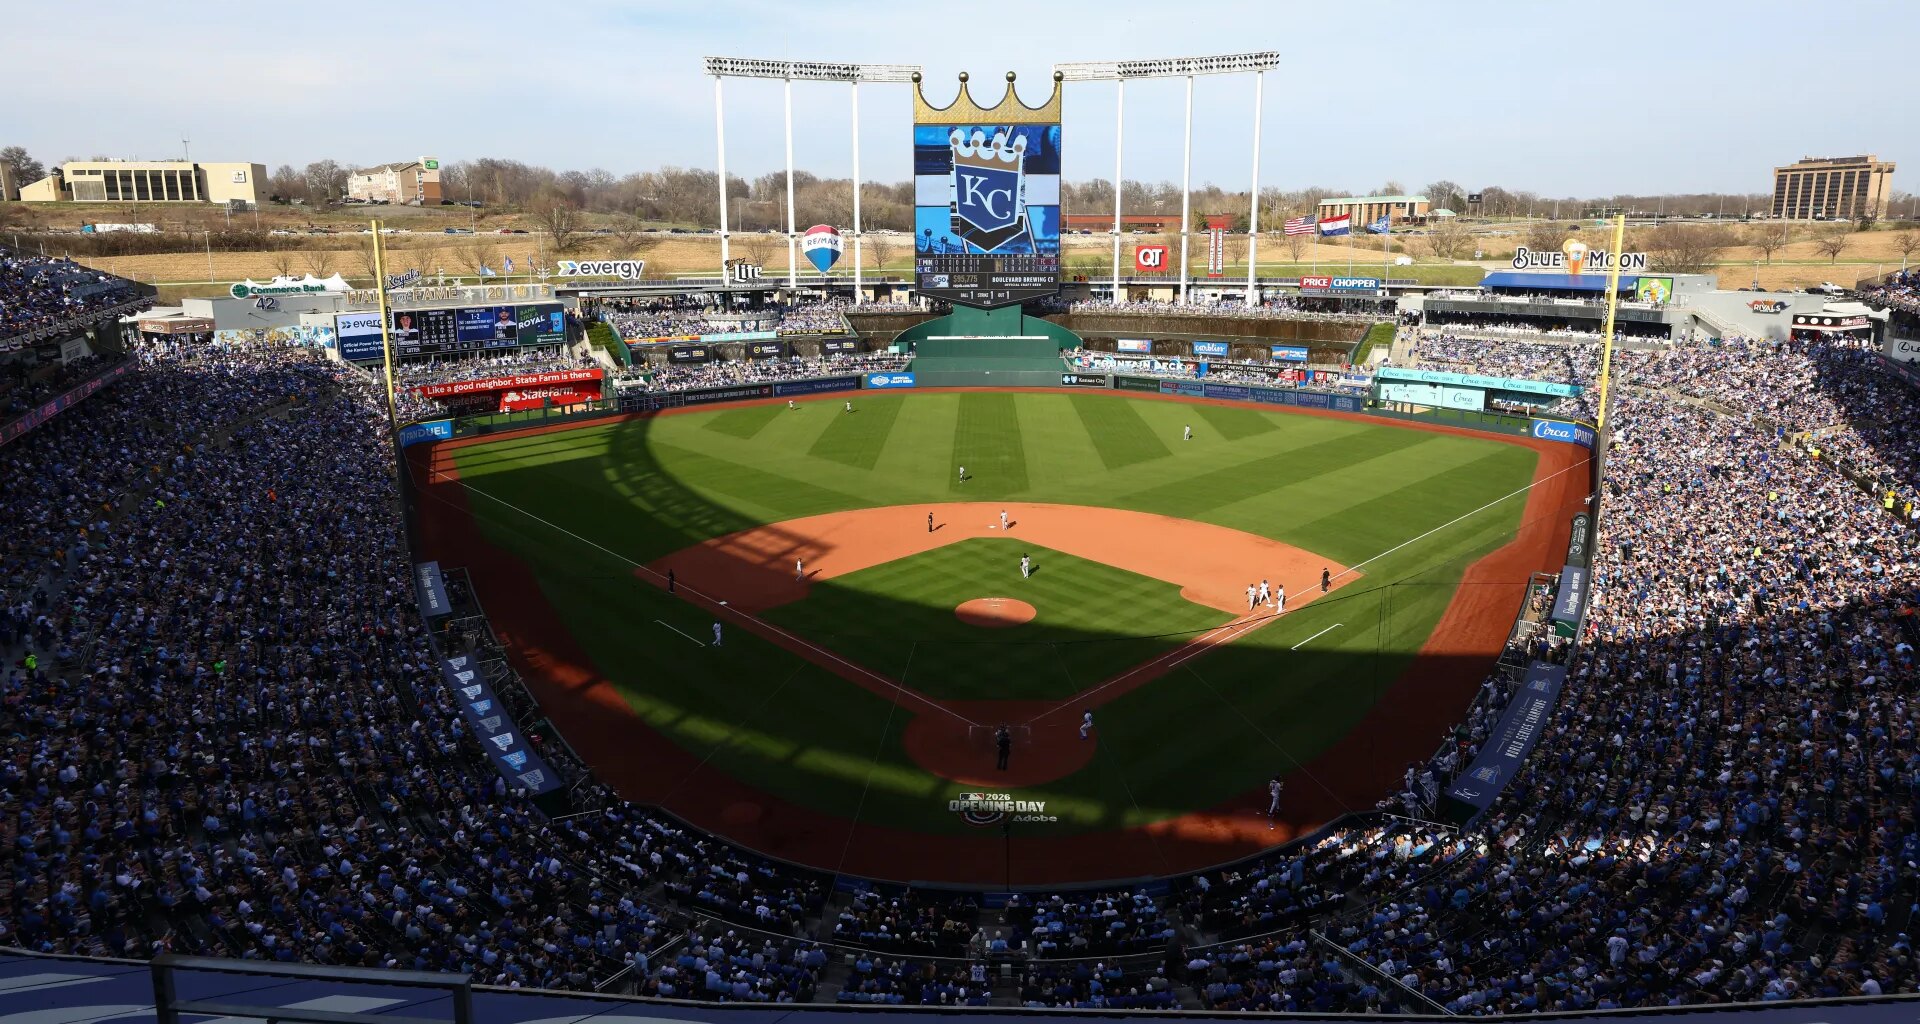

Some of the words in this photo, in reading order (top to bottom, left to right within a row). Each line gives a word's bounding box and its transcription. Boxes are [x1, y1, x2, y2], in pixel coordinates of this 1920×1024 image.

[960, 173, 1012, 220] KC
[807, 237, 839, 247] RE/MAX
[1139, 248, 1163, 267] QT
[1512, 247, 1561, 270] BLUE
[1590, 252, 1646, 268] MOON
[580, 261, 644, 280] evergy
[734, 264, 762, 282] Lite
[384, 268, 422, 288] Royals
[1303, 278, 1328, 286] PRICE
[1333, 278, 1376, 287] CHOPPER
[250, 285, 301, 296] Commerce
[303, 284, 326, 293] Bank
[346, 290, 394, 304] HALL
[412, 287, 460, 302] FAME
[489, 287, 504, 299] 20
[515, 286, 527, 297] 10
[542, 285, 550, 296] 5
[256, 297, 276, 310] 42
[1754, 304, 1781, 312] RIVALS
[518, 315, 546, 329] ROYAL
[1094, 360, 1151, 370] FOUNTAIN
[1154, 361, 1186, 371] DECK
[1383, 368, 1399, 378] Circa
[1421, 371, 1439, 380] Circa
[427, 385, 445, 395] Like
[454, 382, 474, 393] good
[476, 379, 514, 389] neighbor,
[515, 376, 537, 385] State
[538, 374, 560, 383] Farm
[570, 372, 593, 380] there.
[1462, 375, 1479, 384] Circa
[1503, 379, 1521, 389] Circa
[1546, 384, 1564, 393] Circa
[1453, 393, 1473, 403] Circa
[406, 424, 448, 441] FANDUEL
[1535, 421, 1570, 438] Circa
[1574, 428, 1593, 445] SPORTS
[948, 800, 1015, 812] OPENING
[1016, 801, 1046, 812] DAY
